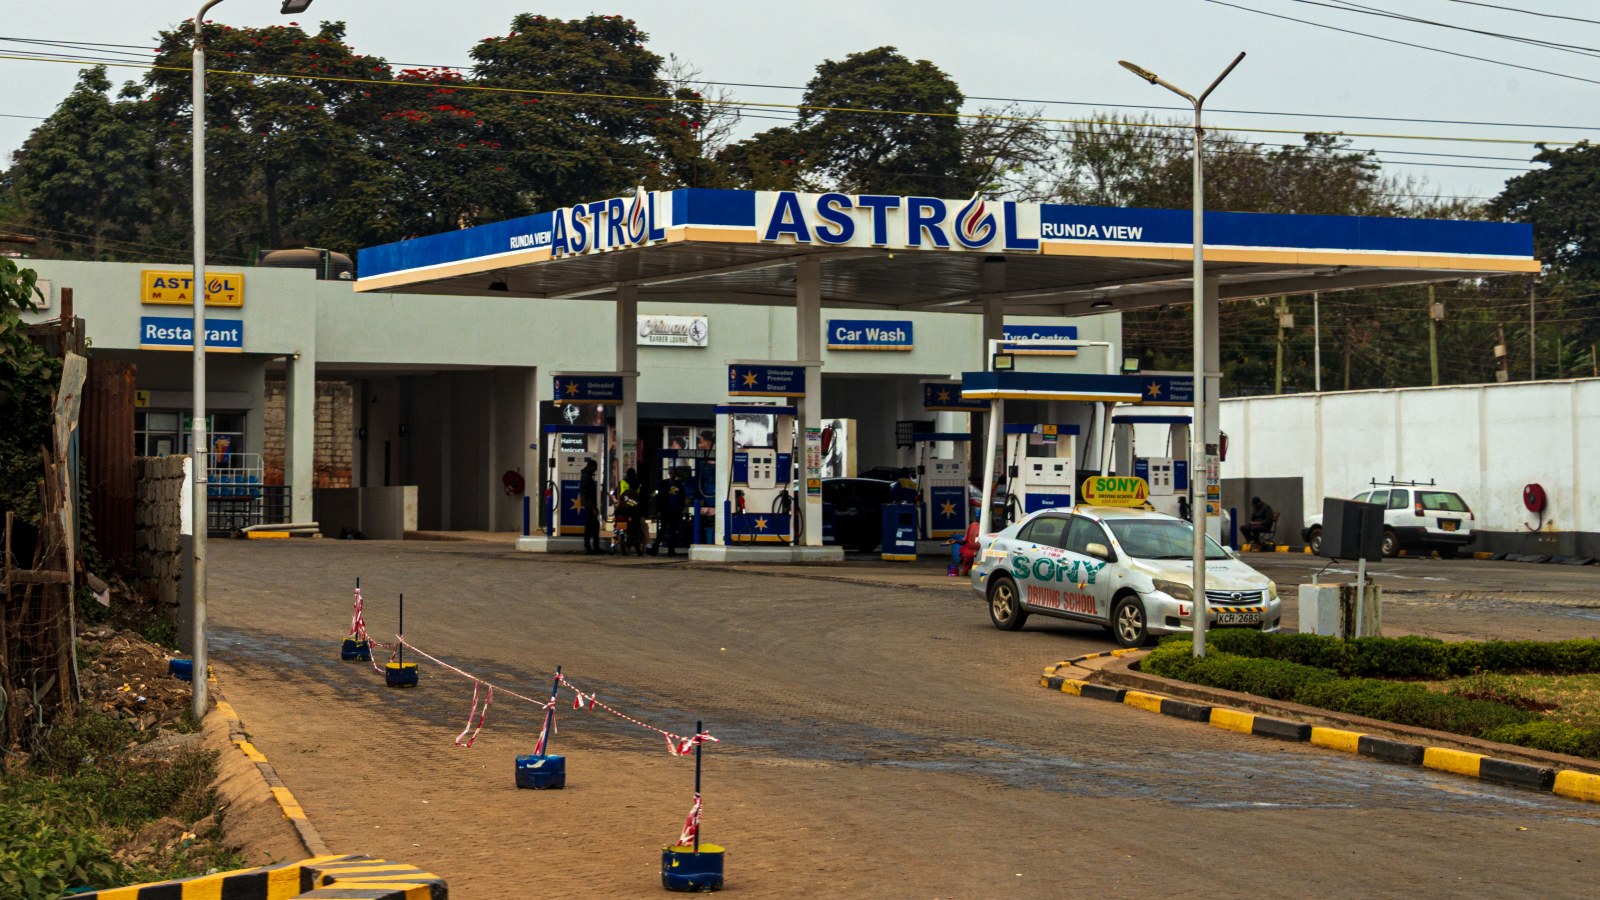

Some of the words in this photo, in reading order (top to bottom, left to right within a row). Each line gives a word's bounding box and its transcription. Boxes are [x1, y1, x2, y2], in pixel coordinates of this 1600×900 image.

[551, 188, 665, 257] ASTROL
[762, 190, 1040, 251] ASTROL
[510, 235, 534, 250] RUNDA
[534, 230, 551, 247] VIEW
[1042, 223, 1099, 239] RUNDA
[1101, 224, 1143, 241] VIEW
[146, 324, 239, 342] Restarant
[836, 327, 861, 342] Car
[865, 327, 906, 343] Wash
[561, 437, 583, 445] Haircut
[1095, 477, 1139, 493] SONY
[1010, 555, 1107, 585] SONY
[1026, 584, 1061, 609] DRIVING
[1063, 591, 1098, 615] SCHOOL
